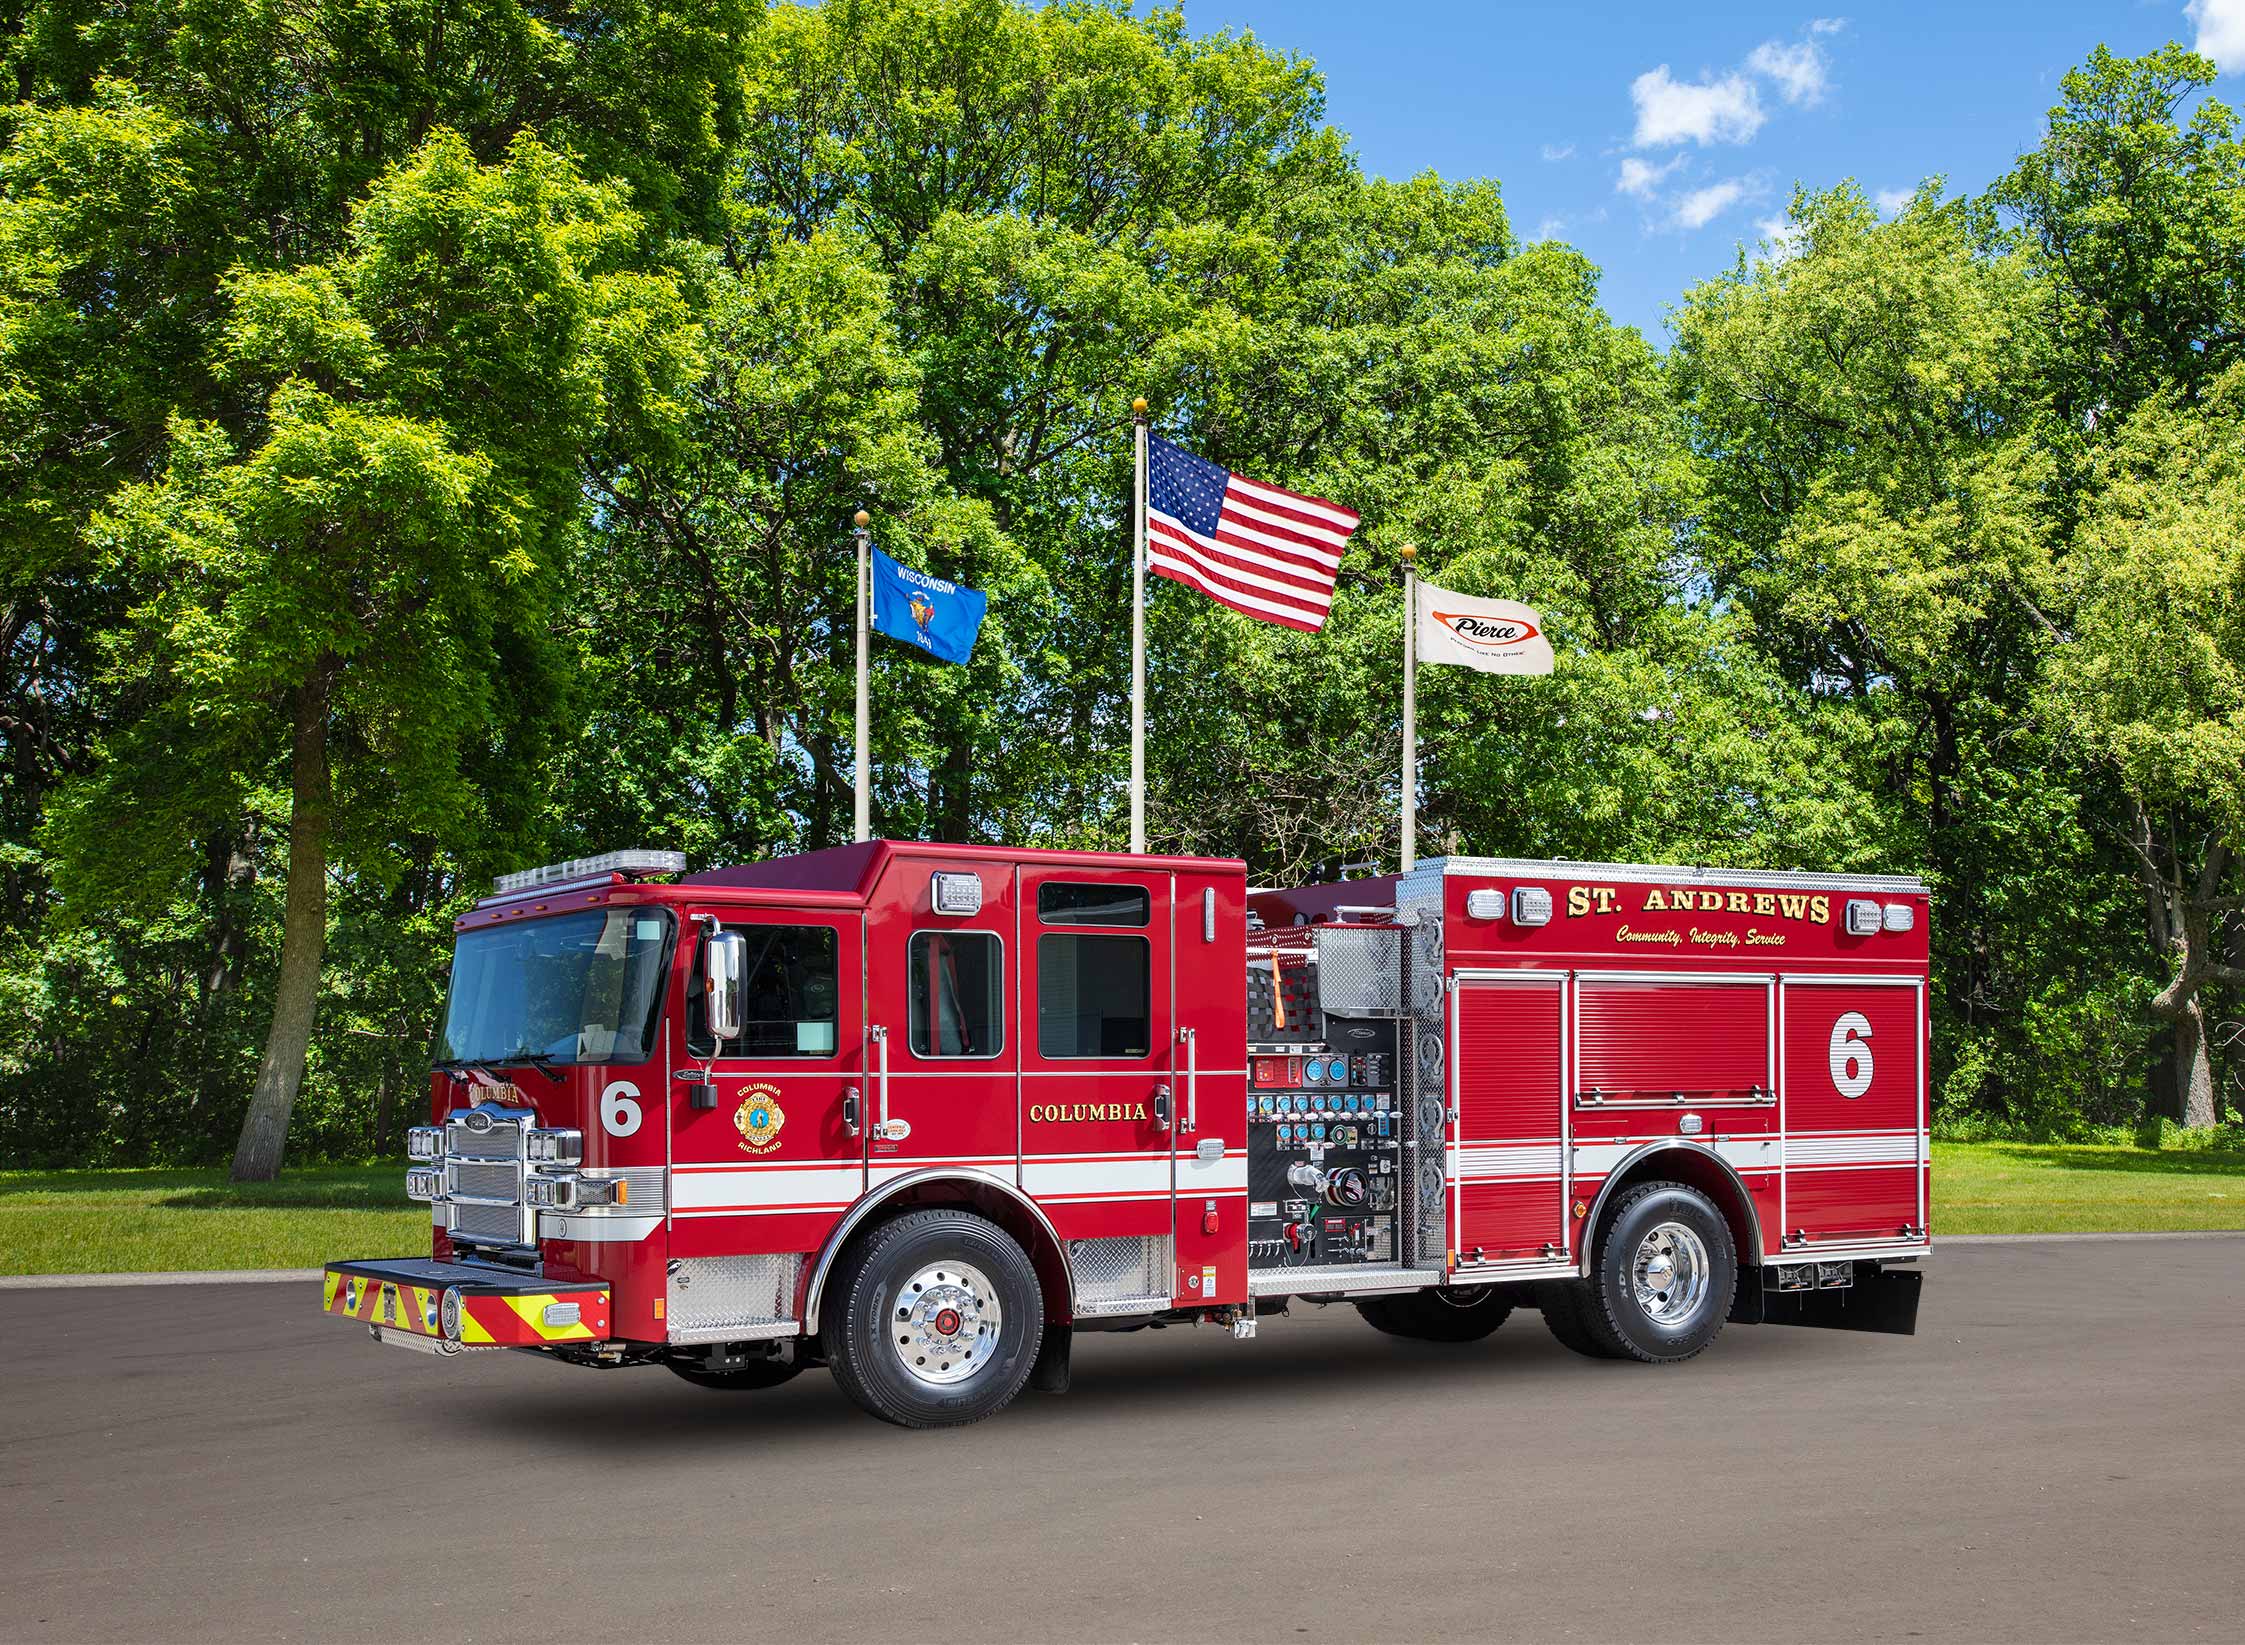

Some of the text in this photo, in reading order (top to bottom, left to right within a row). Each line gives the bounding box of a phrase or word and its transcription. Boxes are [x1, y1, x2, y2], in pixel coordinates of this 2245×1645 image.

[897, 566, 956, 595] WISCONSIN
[1455, 618, 1516, 639] Pierce
[1567, 886, 1831, 925] ST. ANDREWS
[1616, 925, 1786, 949] Community, Integrity, Service
[1828, 1010, 1875, 1099] 6
[470, 1083, 519, 1104] OLUMBIA
[736, 1083, 782, 1097] COLUMBIA
[599, 1080, 643, 1137] 6
[1029, 1103, 1148, 1122] COLUMBIA
[737, 1141, 783, 1155] RICHLAND
